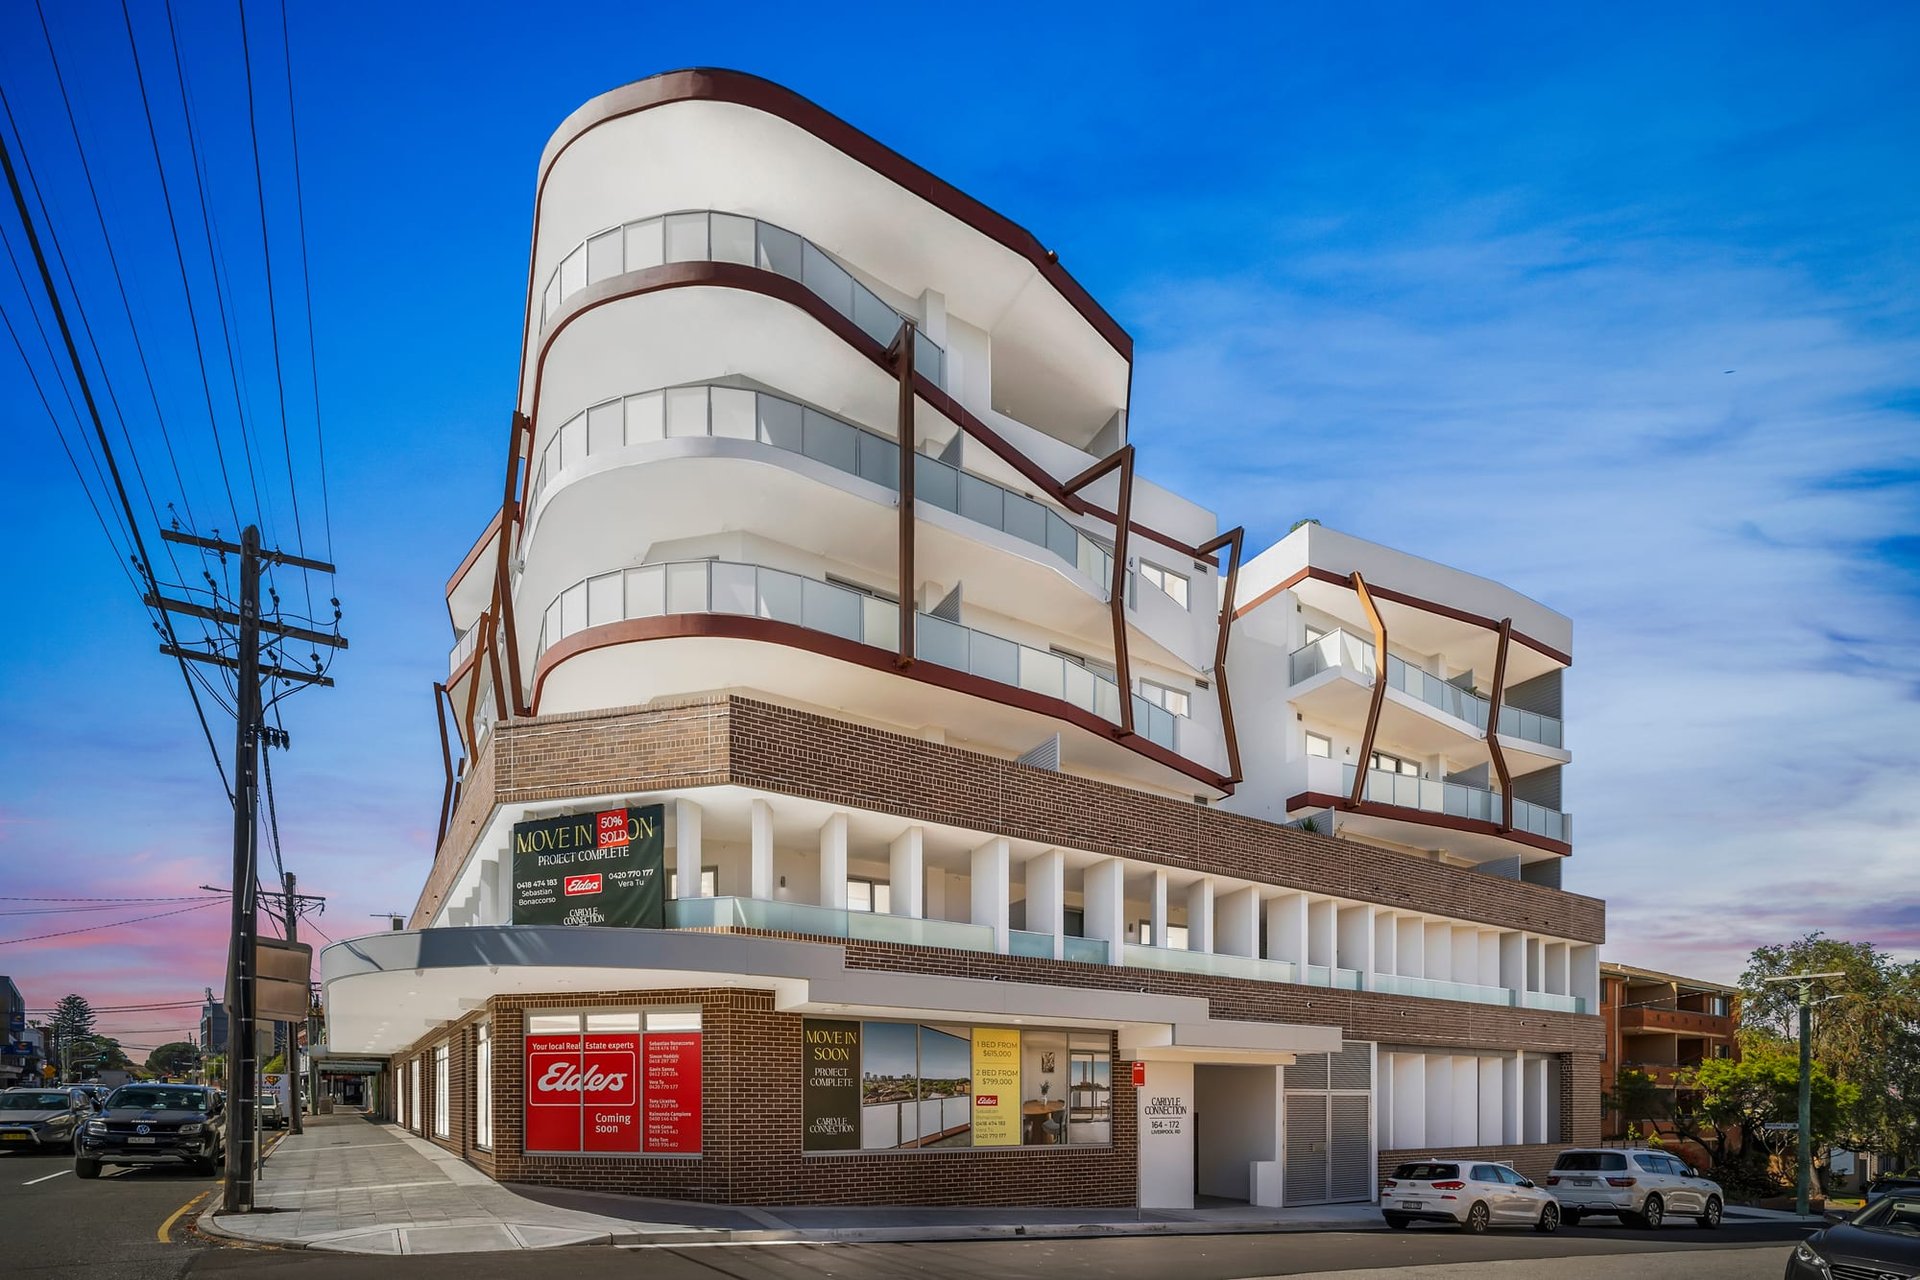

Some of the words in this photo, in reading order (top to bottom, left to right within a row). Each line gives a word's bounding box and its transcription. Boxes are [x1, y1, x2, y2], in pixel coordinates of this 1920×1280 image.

[601, 816, 622, 828] 50%
[516, 826, 570, 853] MOVE
[575, 824, 592, 846] IN
[600, 830, 627, 844] SOLD
[538, 852, 576, 866] PROJECT
[578, 846, 629, 862] COMPLETE
[609, 871, 626, 880] 0420
[567, 880, 599, 892] Elders
[618, 880, 634, 888] Vera
[521, 888, 552, 897] Sebastian
[519, 897, 556, 905] Bonaccorso
[570, 907, 598, 916] CARLYLE
[563, 914, 604, 925] CONNECTION
[806, 1030, 842, 1044] MOVE
[845, 1032, 857, 1044] IN
[608, 1042, 634, 1050] experts
[814, 1047, 849, 1061] SOON
[538, 1062, 628, 1092] Elders
[815, 1068, 848, 1077] PROJECT
[810, 1078, 853, 1087] COMPLETE
[1152, 1097, 1180, 1106] CARLYLE
[1145, 1106, 1187, 1115] CONNECTION
[595, 1113, 631, 1125] Coming
[595, 1125, 618, 1133] soon
[809, 1125, 854, 1134] CONNECTION
